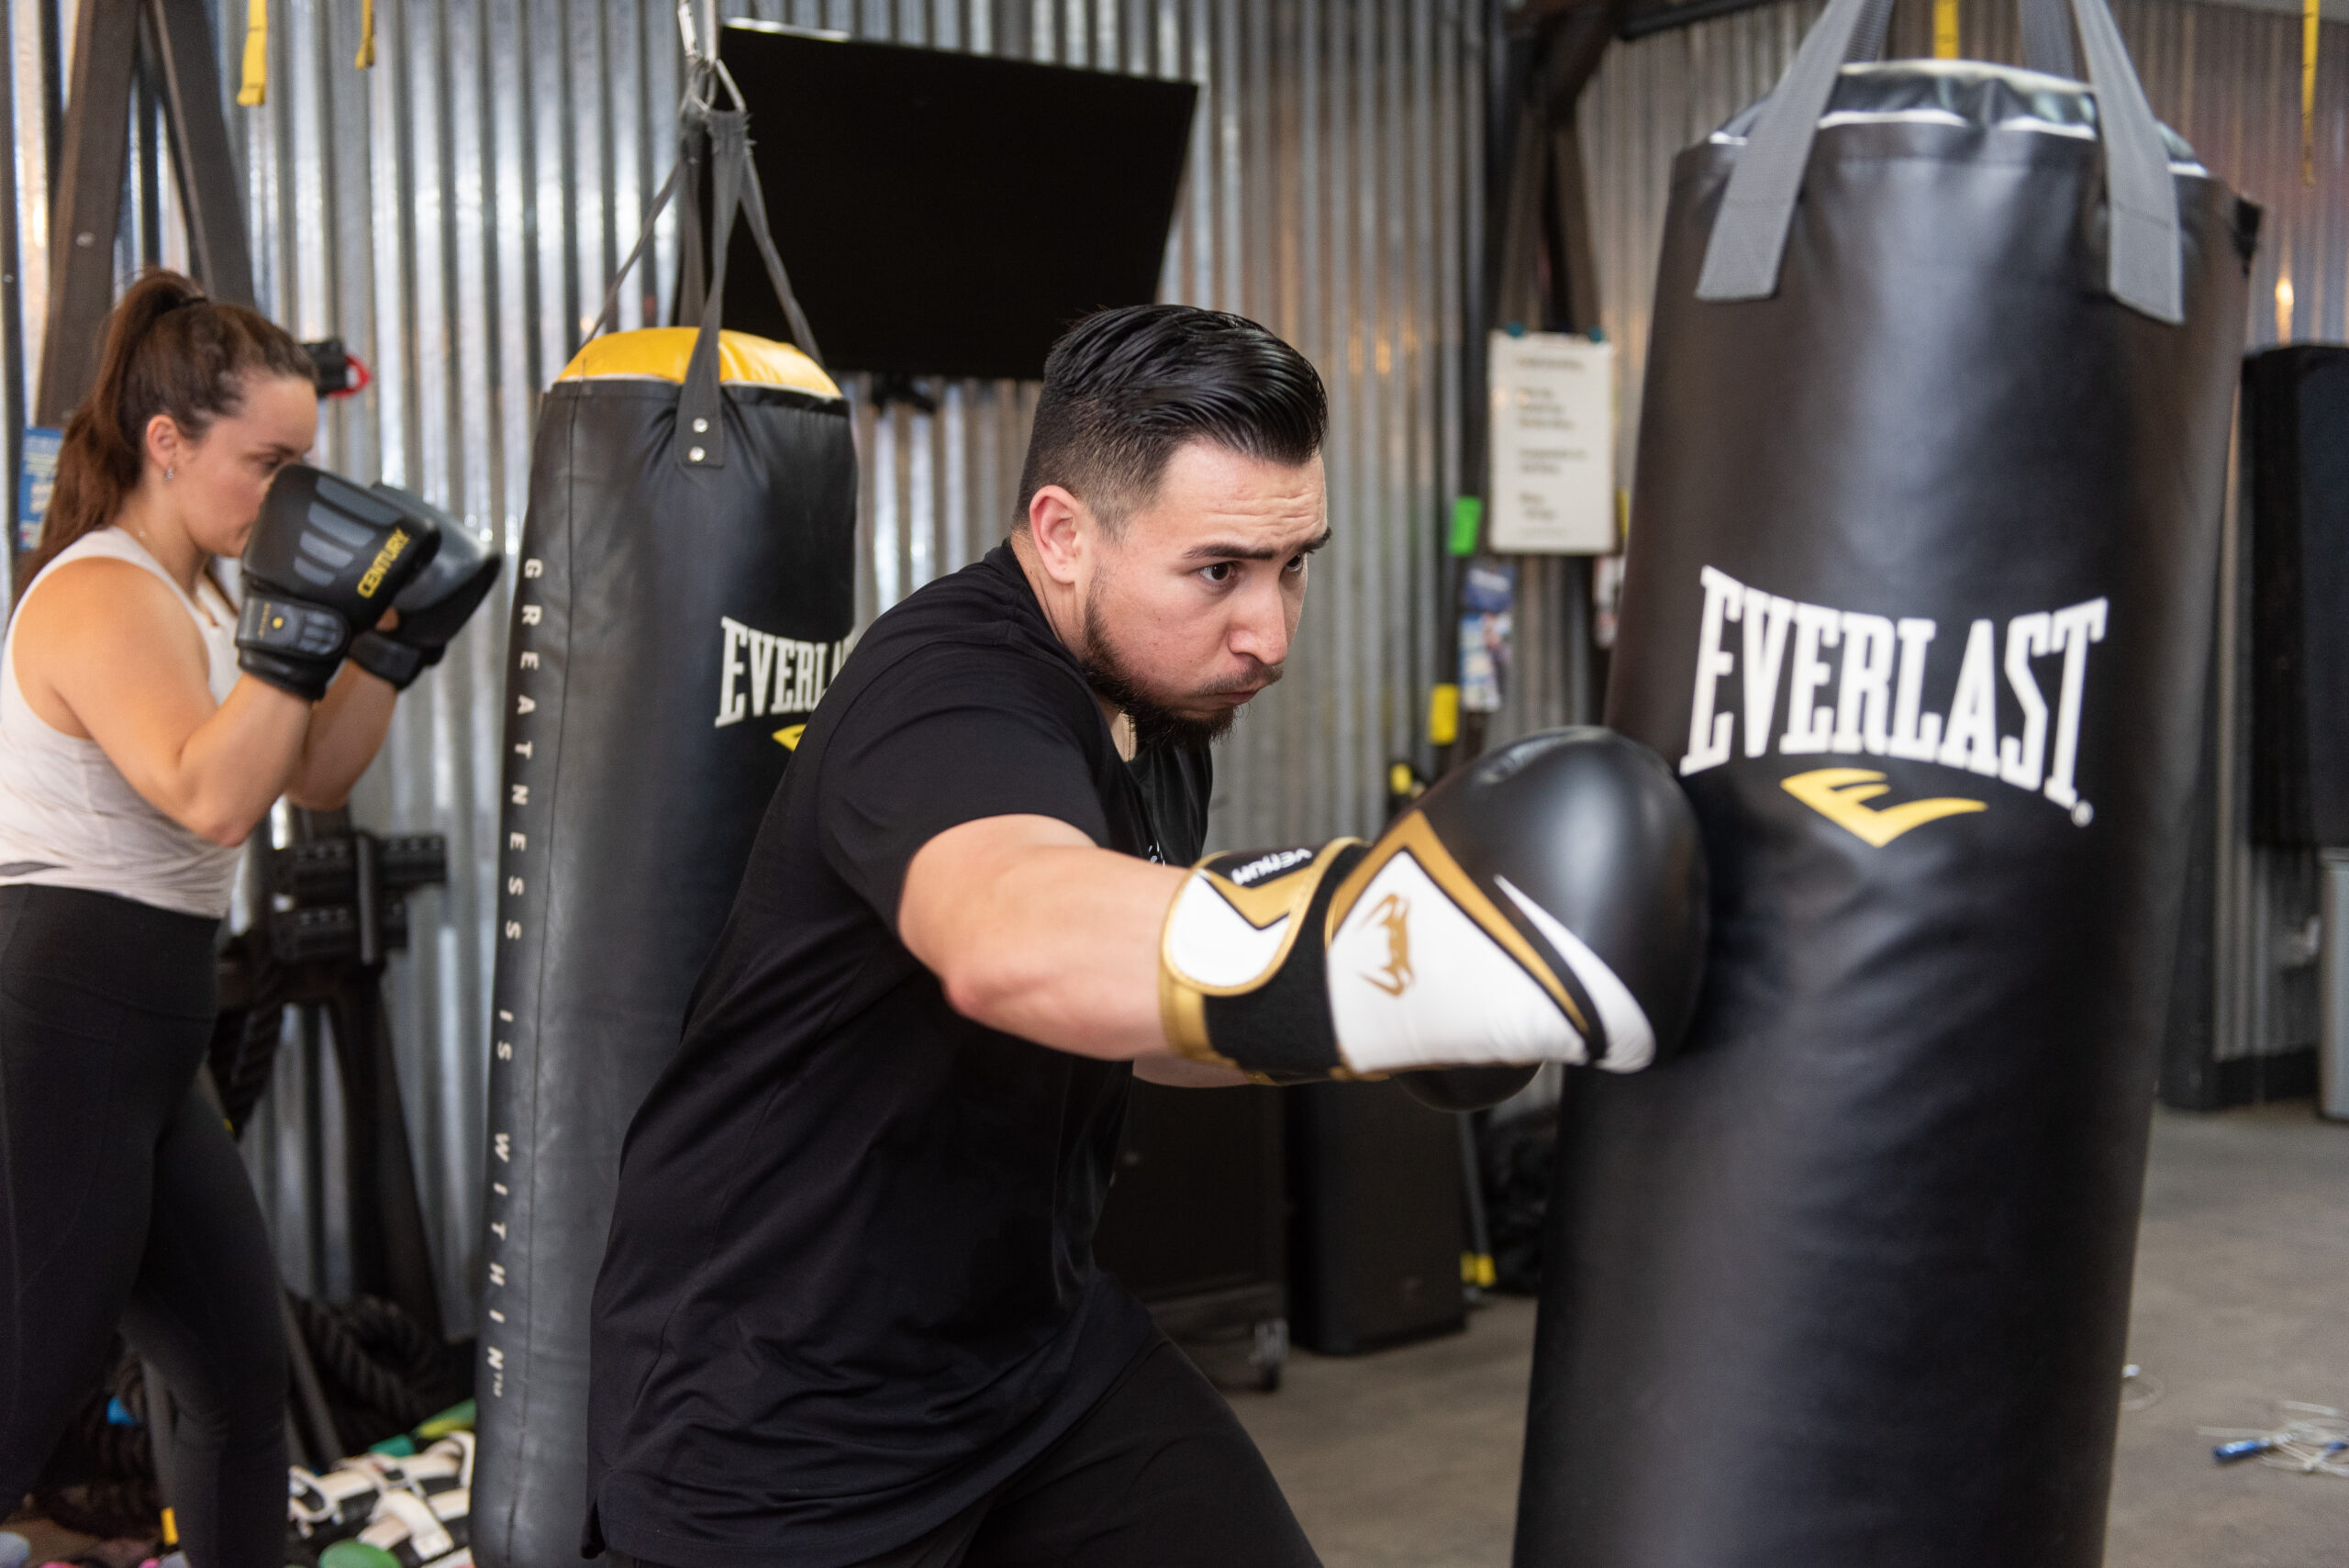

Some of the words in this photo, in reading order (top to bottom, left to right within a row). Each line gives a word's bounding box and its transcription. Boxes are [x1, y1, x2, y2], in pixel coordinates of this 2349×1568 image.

[506, 558, 543, 940] GREATNESS
[1679, 564, 2109, 810] EVERLAST
[497, 1010, 514, 1060] IS
